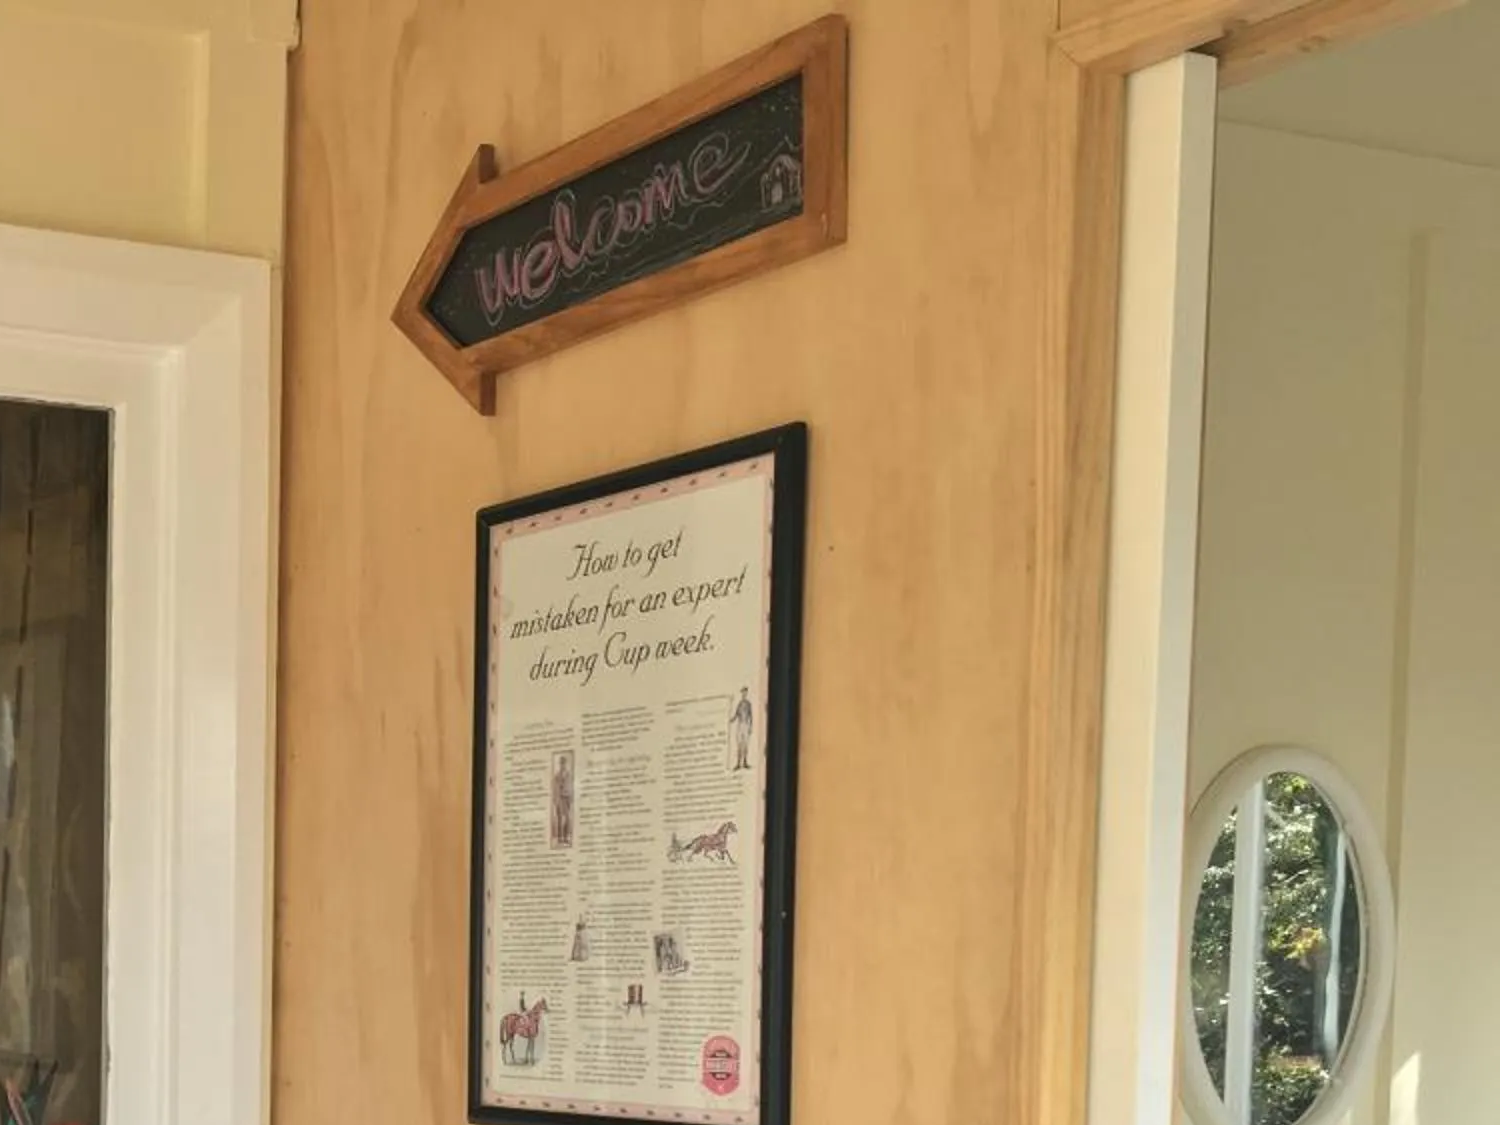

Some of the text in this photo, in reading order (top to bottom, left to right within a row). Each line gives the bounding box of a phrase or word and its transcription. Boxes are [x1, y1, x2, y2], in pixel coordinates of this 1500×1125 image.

[473, 132, 752, 326] welcome
[566, 525, 686, 582] How to get
[509, 565, 748, 640] mistaken for an expert
[529, 614, 716, 687] during Cup week.
